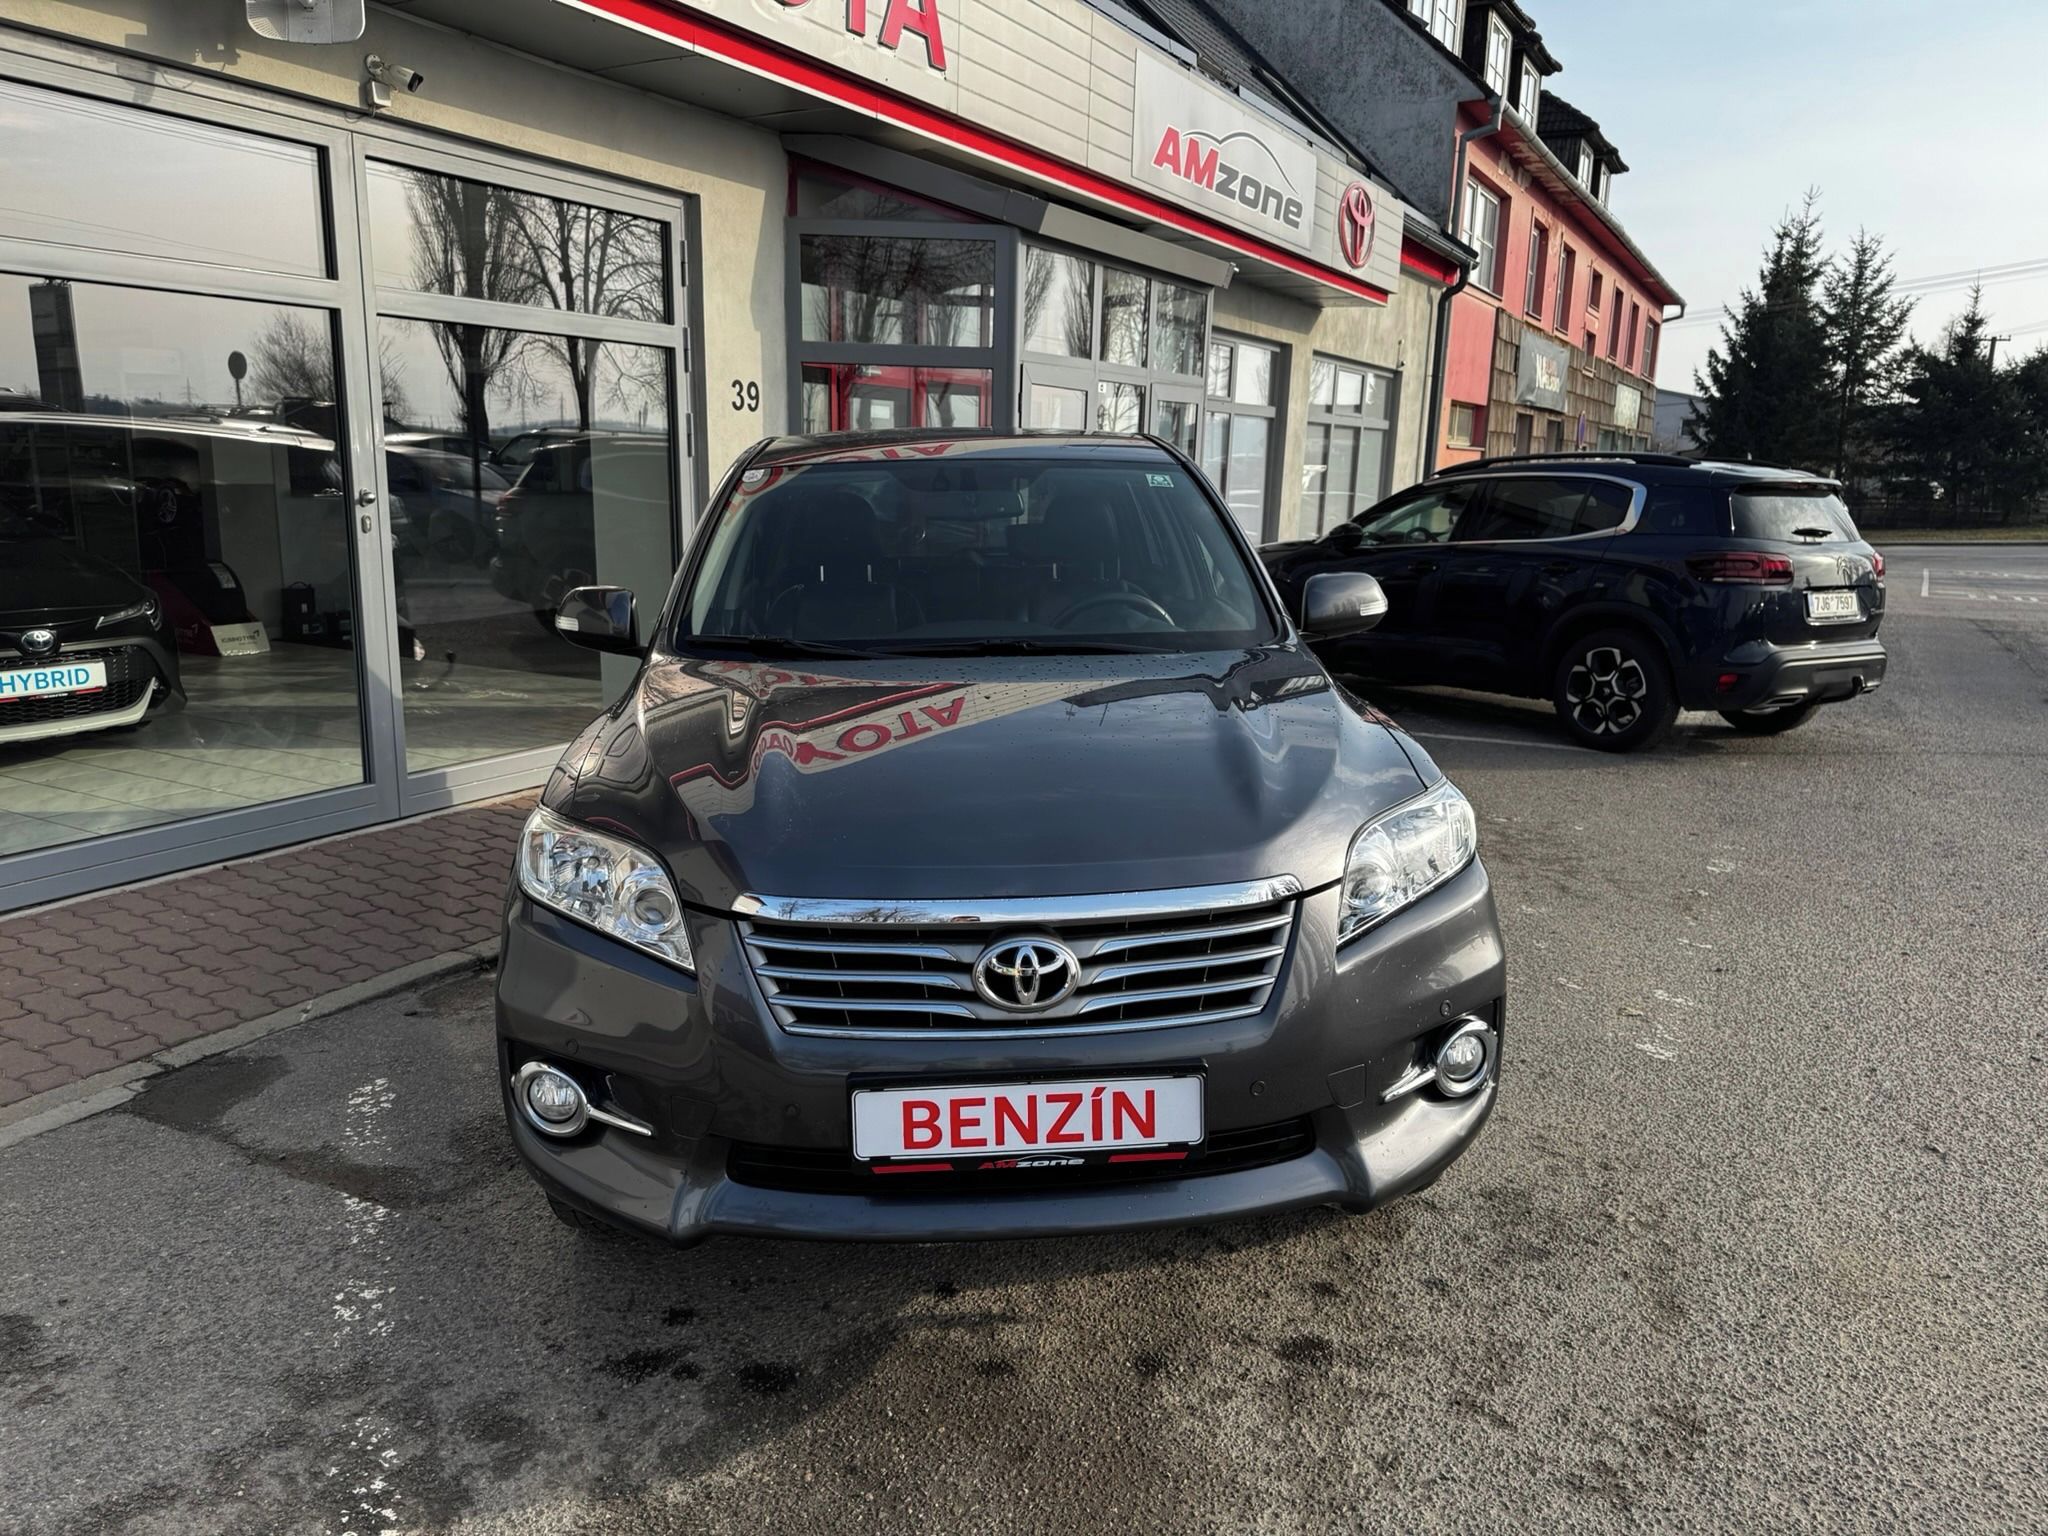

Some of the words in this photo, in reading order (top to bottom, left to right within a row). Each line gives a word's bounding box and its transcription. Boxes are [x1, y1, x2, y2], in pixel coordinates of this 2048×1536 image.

[1152, 125, 1303, 230] AMzone
[731, 379, 760, 412] 39
[0, 668, 90, 694] HYBRID
[902, 1086, 1156, 1150] BENZÍN
